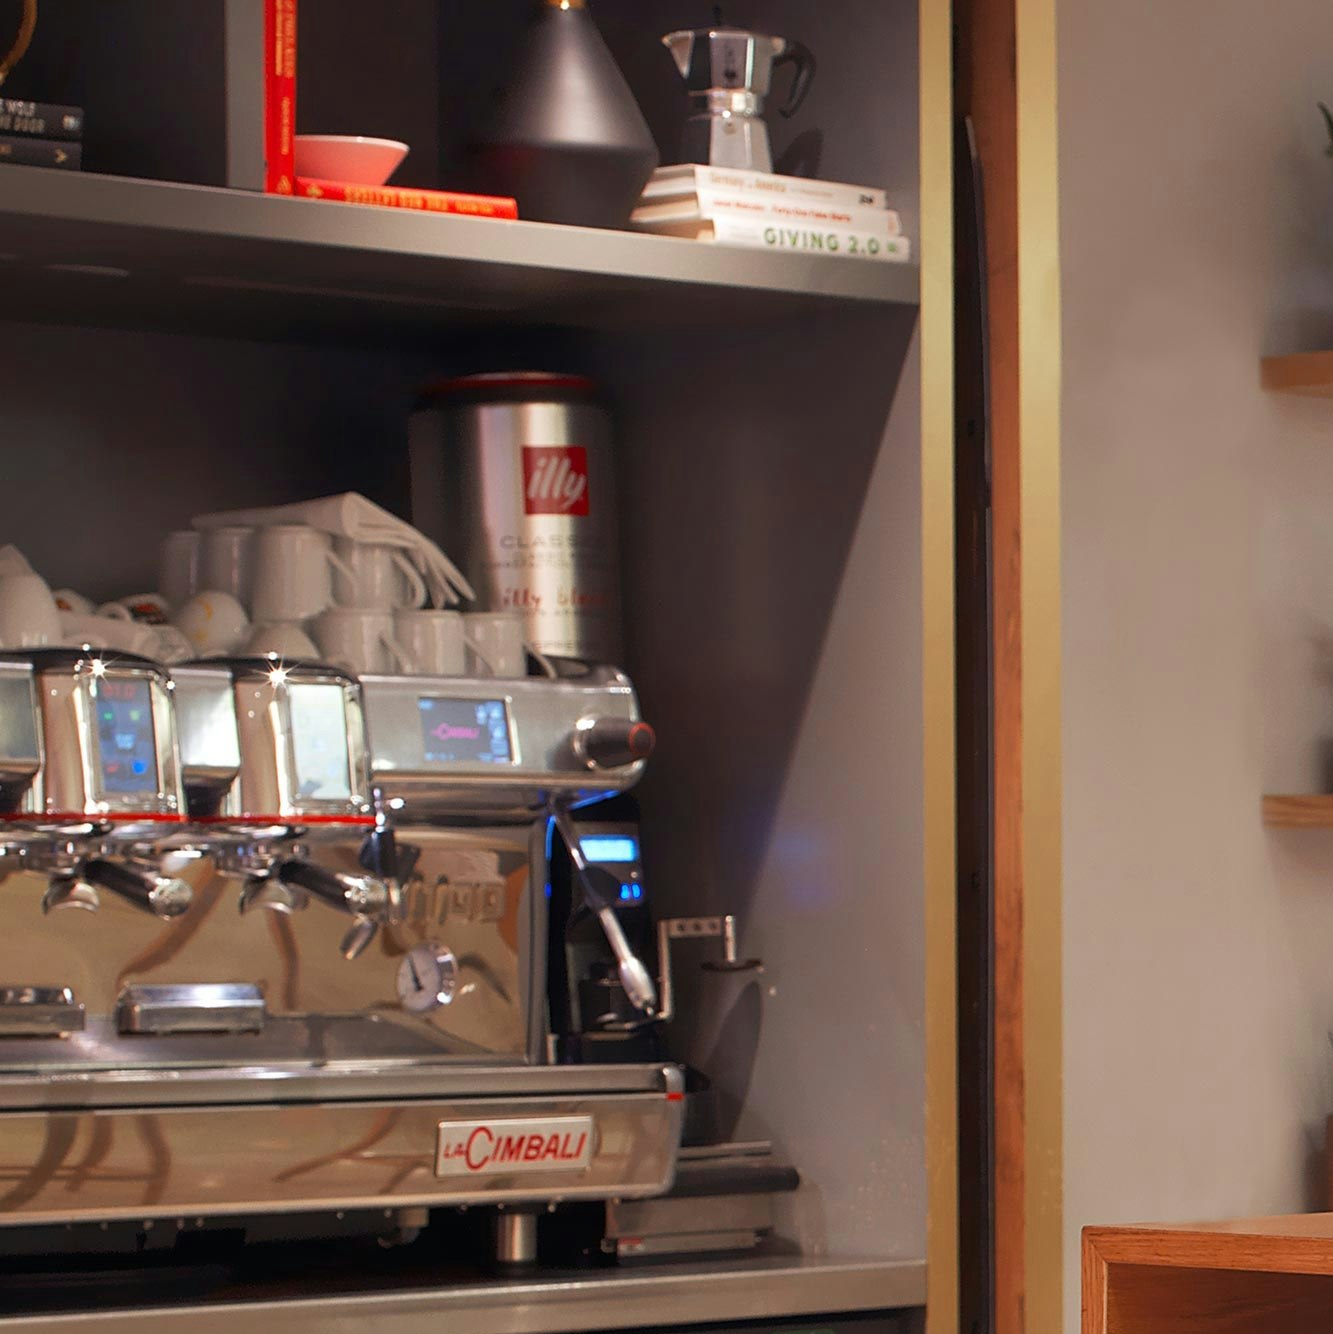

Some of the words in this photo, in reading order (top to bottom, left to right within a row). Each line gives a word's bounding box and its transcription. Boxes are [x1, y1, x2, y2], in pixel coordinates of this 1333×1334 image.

[764, 226, 839, 251] GIVING
[528, 457, 586, 509] illy
[465, 1126, 588, 1171] CIMBALI
